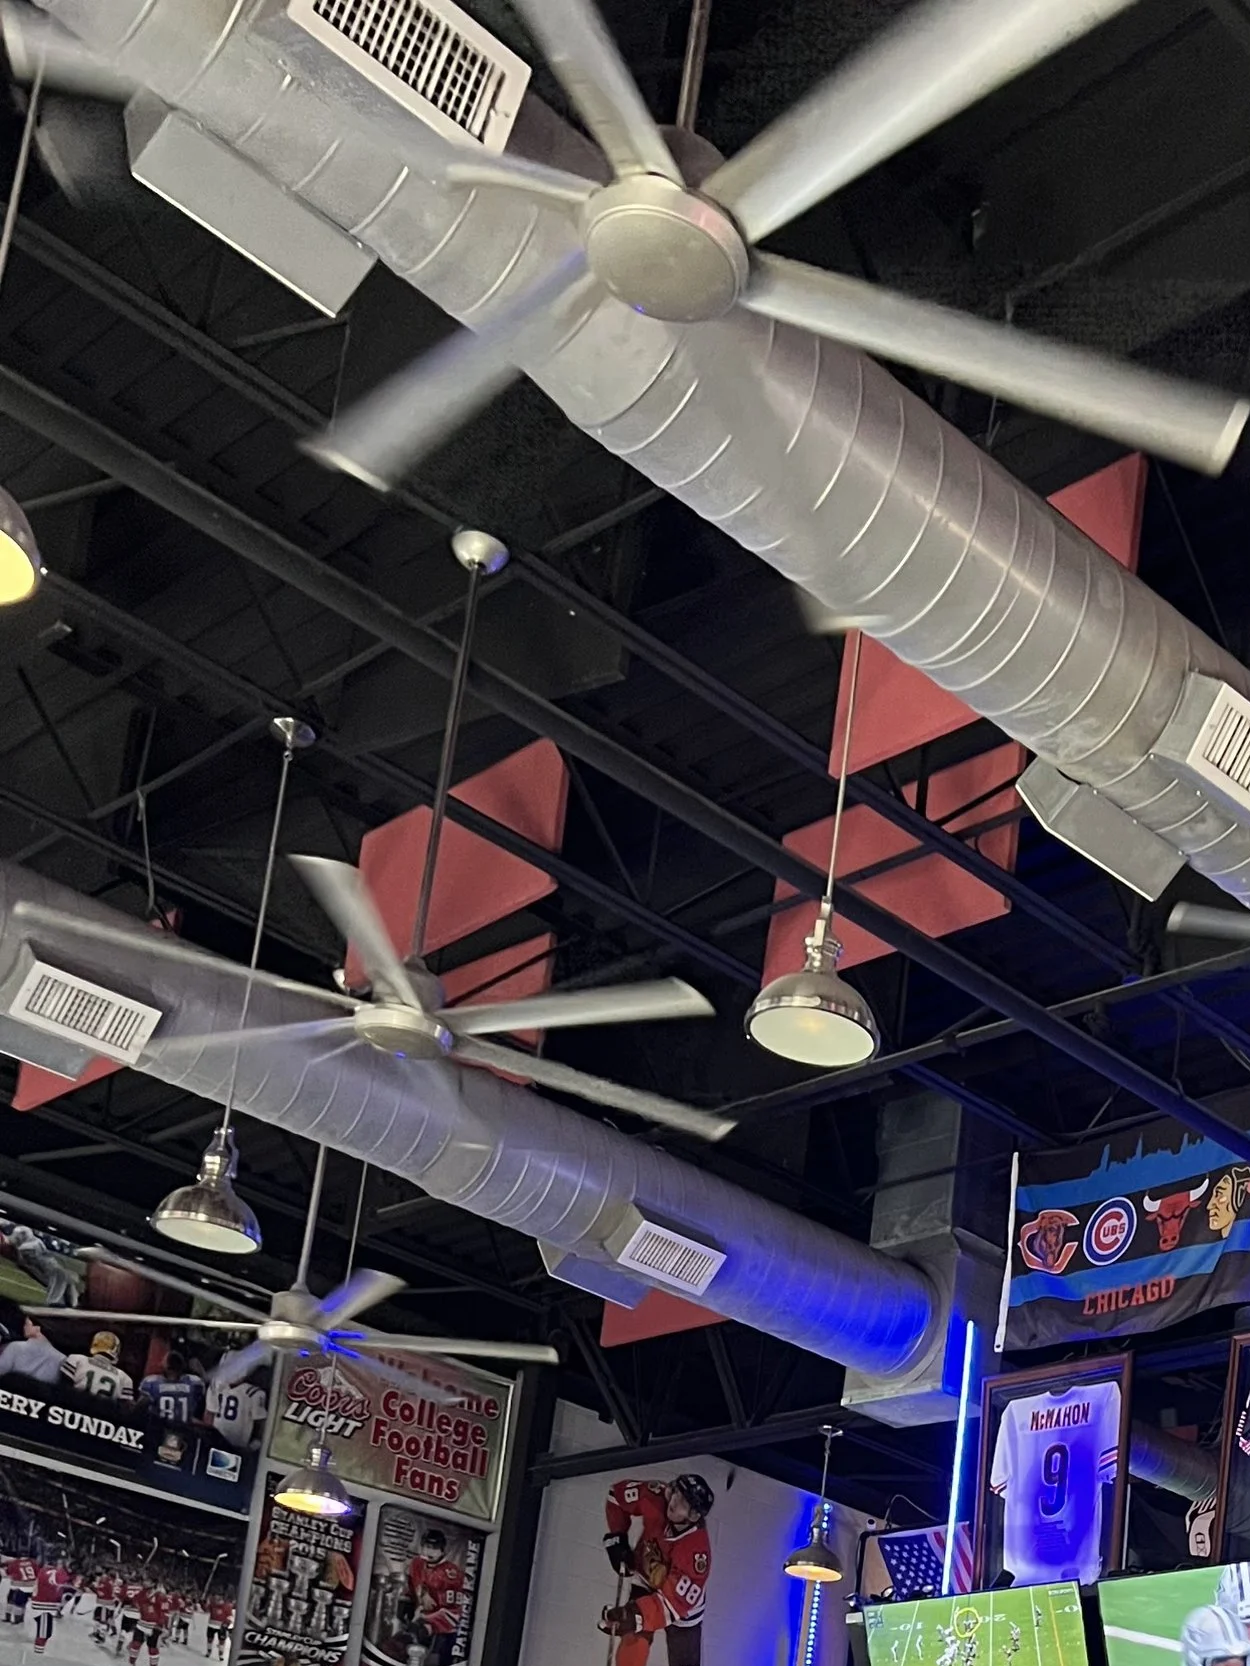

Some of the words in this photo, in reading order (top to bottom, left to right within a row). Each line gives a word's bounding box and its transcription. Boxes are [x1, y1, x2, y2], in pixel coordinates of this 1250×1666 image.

[1083, 1276, 1176, 1316] CHICAGO
[286, 1367, 372, 1422] Coors
[48, 1406, 145, 1450] SUNDAY.
[283, 1402, 364, 1438] LIGHT
[382, 1389, 488, 1448] College
[1030, 1402, 1091, 1432] McMAHON
[371, 1416, 490, 1478] Football
[394, 1456, 461, 1502] Fans
[1039, 1443, 1072, 1519] 9
[269, 1521, 353, 1554] CHAMPIONS
[271, 1506, 329, 1531] STANLEY
[287, 1540, 327, 1561] 2015
[19, 1566, 36, 1582] 19
[673, 1574, 702, 1604] 88
[451, 1592, 474, 1659] PATRICK
[463, 1540, 481, 1592] KANE
[244, 1631, 342, 1665] CHAMPIONS
